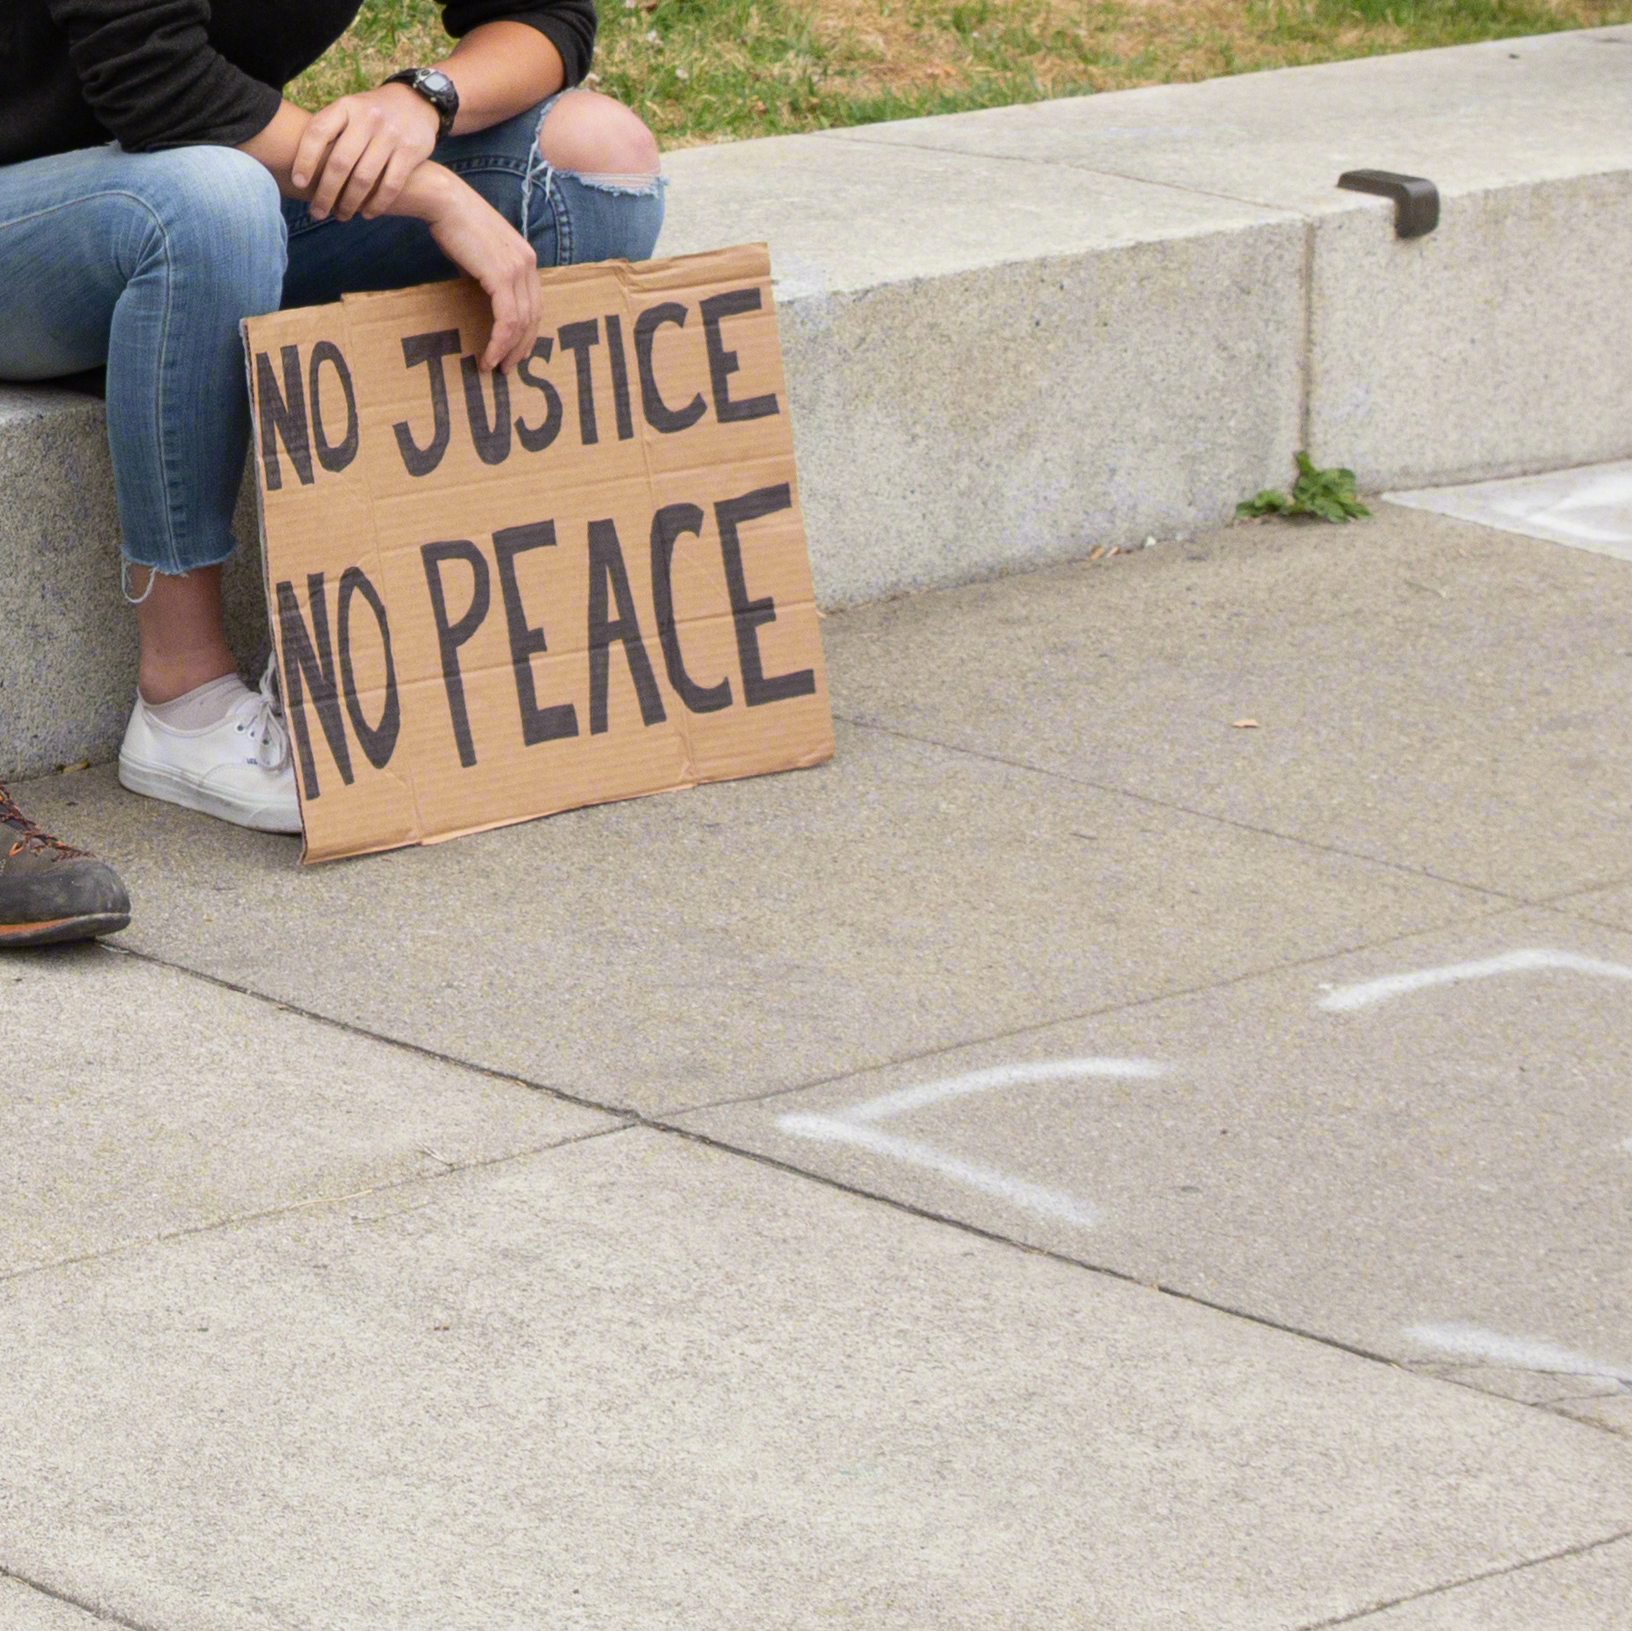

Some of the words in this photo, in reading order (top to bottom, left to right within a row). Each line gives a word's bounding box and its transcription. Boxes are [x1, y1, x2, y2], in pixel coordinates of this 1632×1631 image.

[255, 339, 360, 490] NO
[392, 287, 780, 477] JUSTICE
[275, 566, 400, 800] NO
[420, 482, 816, 768] PEACE
